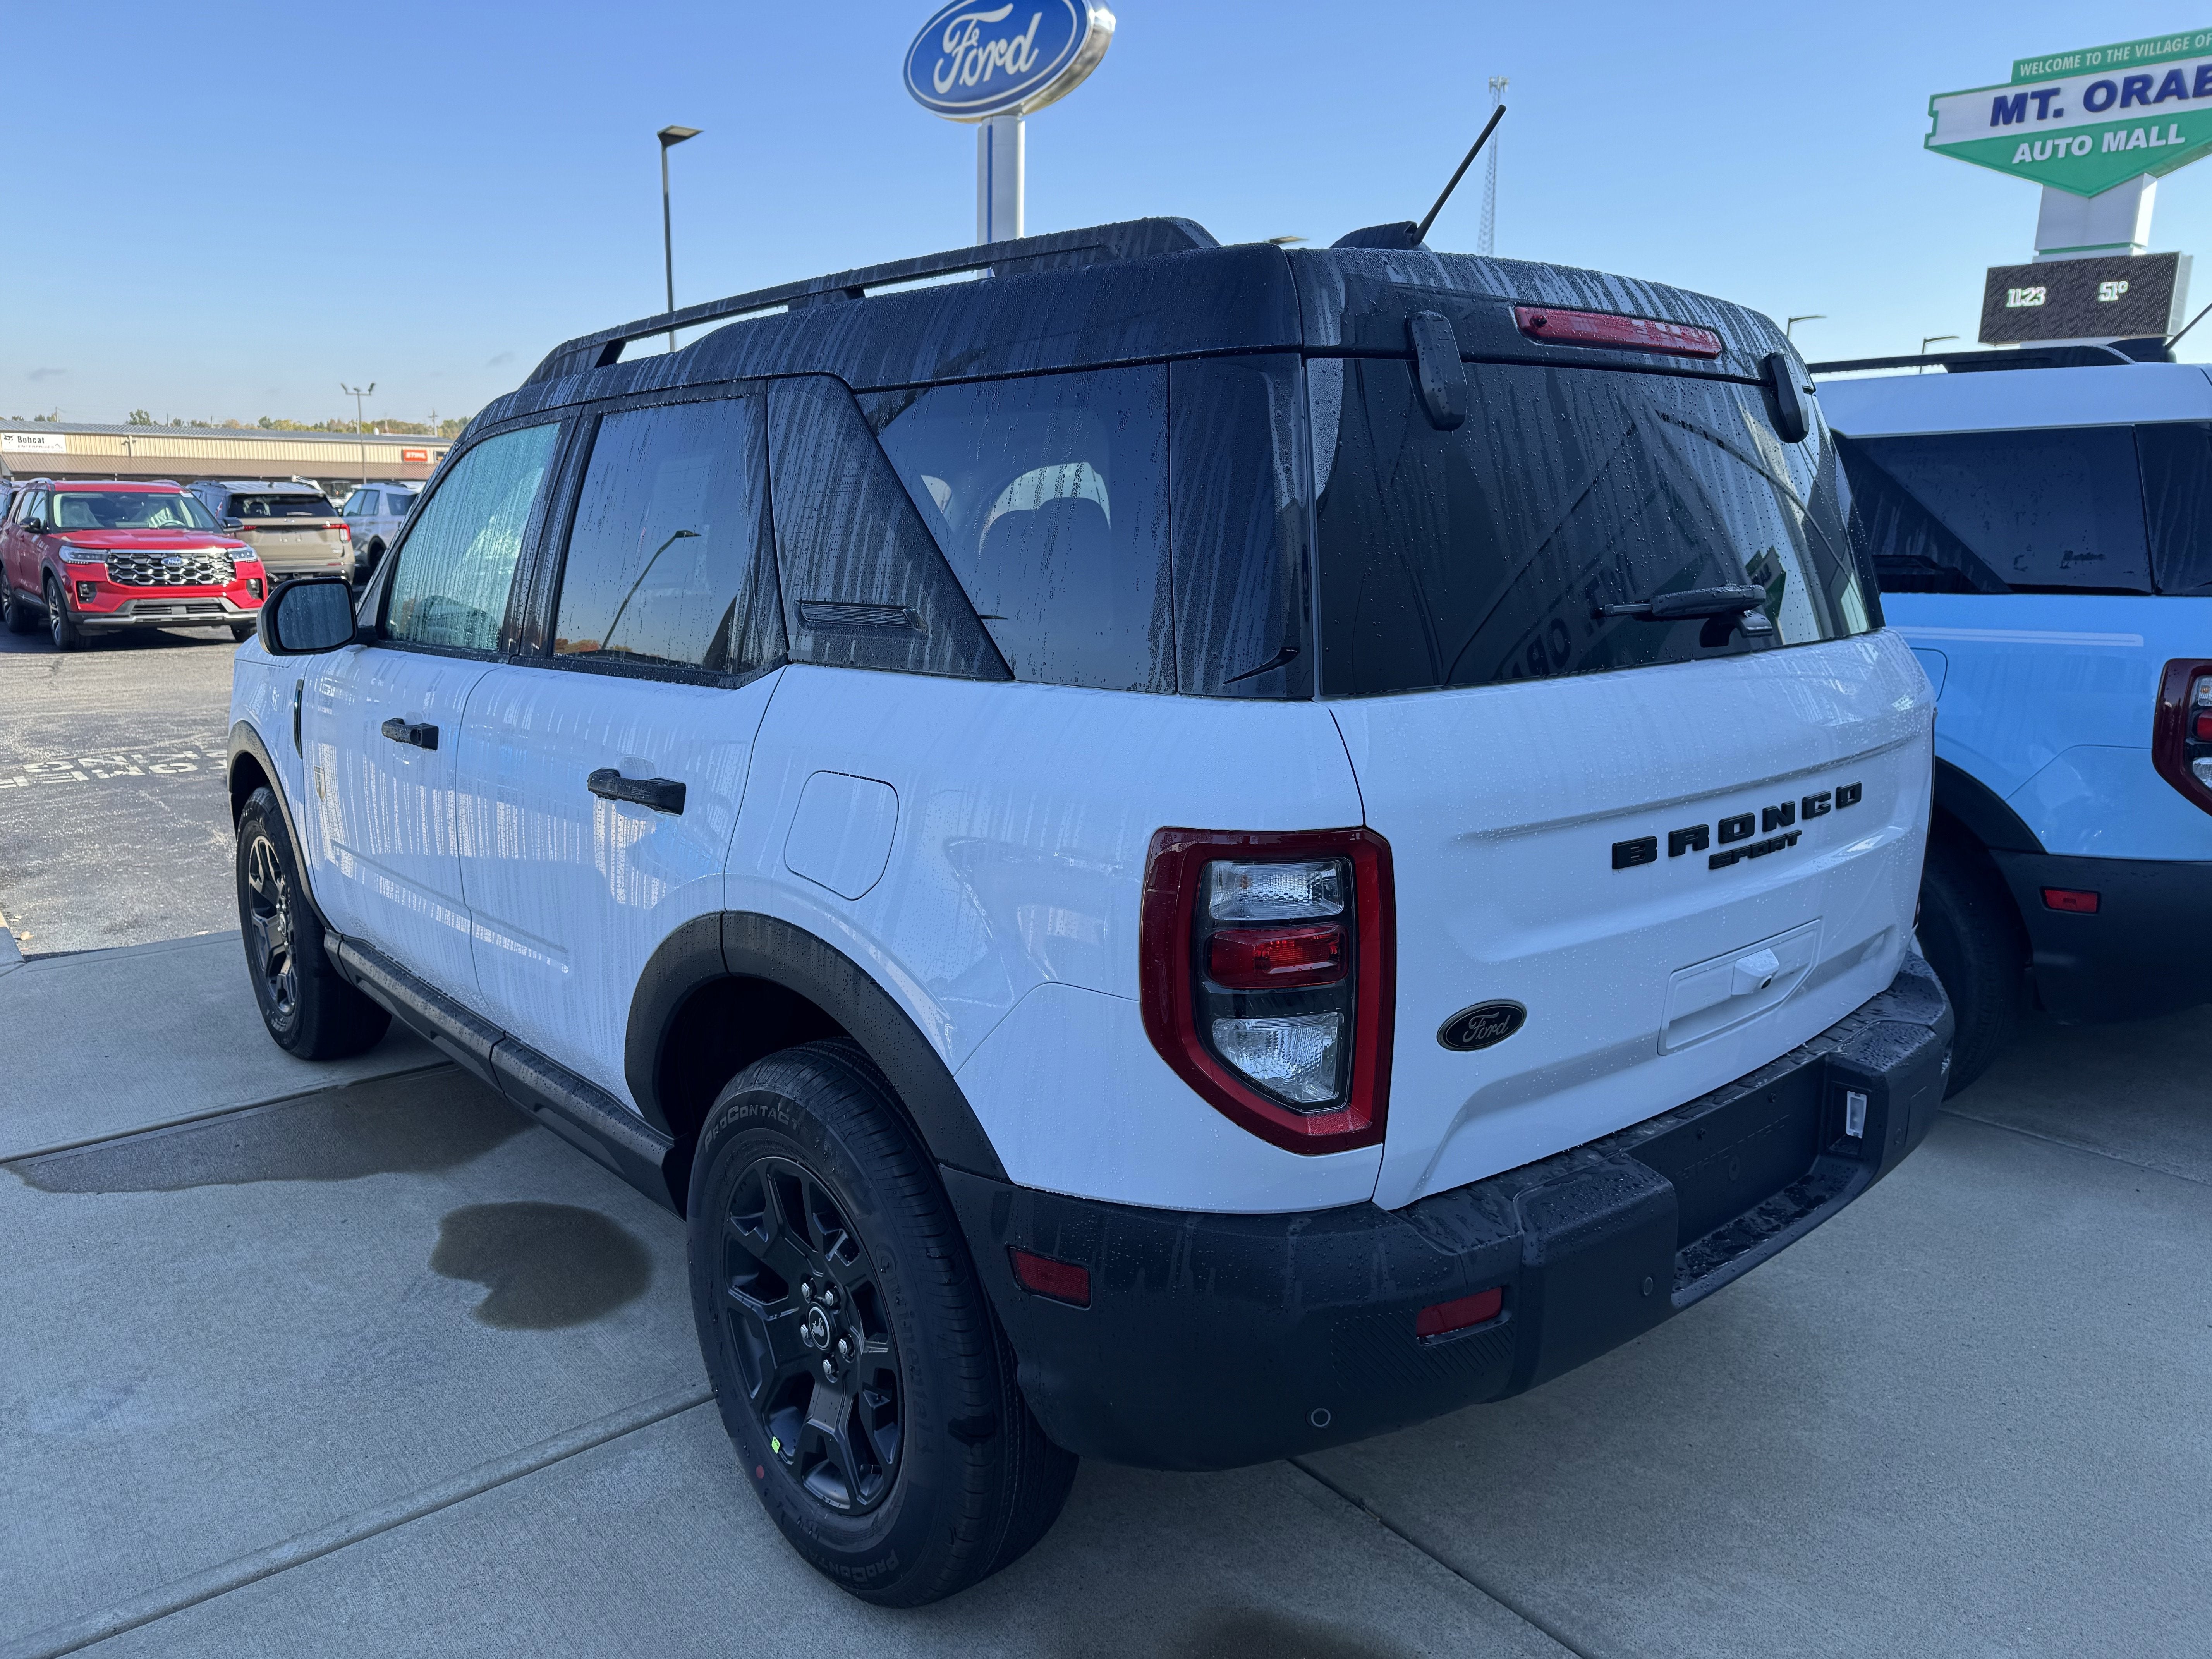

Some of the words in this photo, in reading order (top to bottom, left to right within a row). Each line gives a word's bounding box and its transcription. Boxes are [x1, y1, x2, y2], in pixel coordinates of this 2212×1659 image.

[933, 3, 1042, 94] Ford
[2020, 55, 2081, 77] WELCOME
[2086, 51, 2102, 66] TO
[2107, 47, 2130, 62] THE
[2135, 36, 2190, 57] VILLAGE
[2195, 33, 2212, 48] OF
[1990, 87, 2064, 127] MT.
[2012, 135, 2092, 163] AUTO
[2102, 124, 2185, 153] MALL
[1612, 781, 1862, 870] BRONCO
[1709, 830, 1802, 870] SPORT
[1463, 1012, 1511, 1043] Ford
